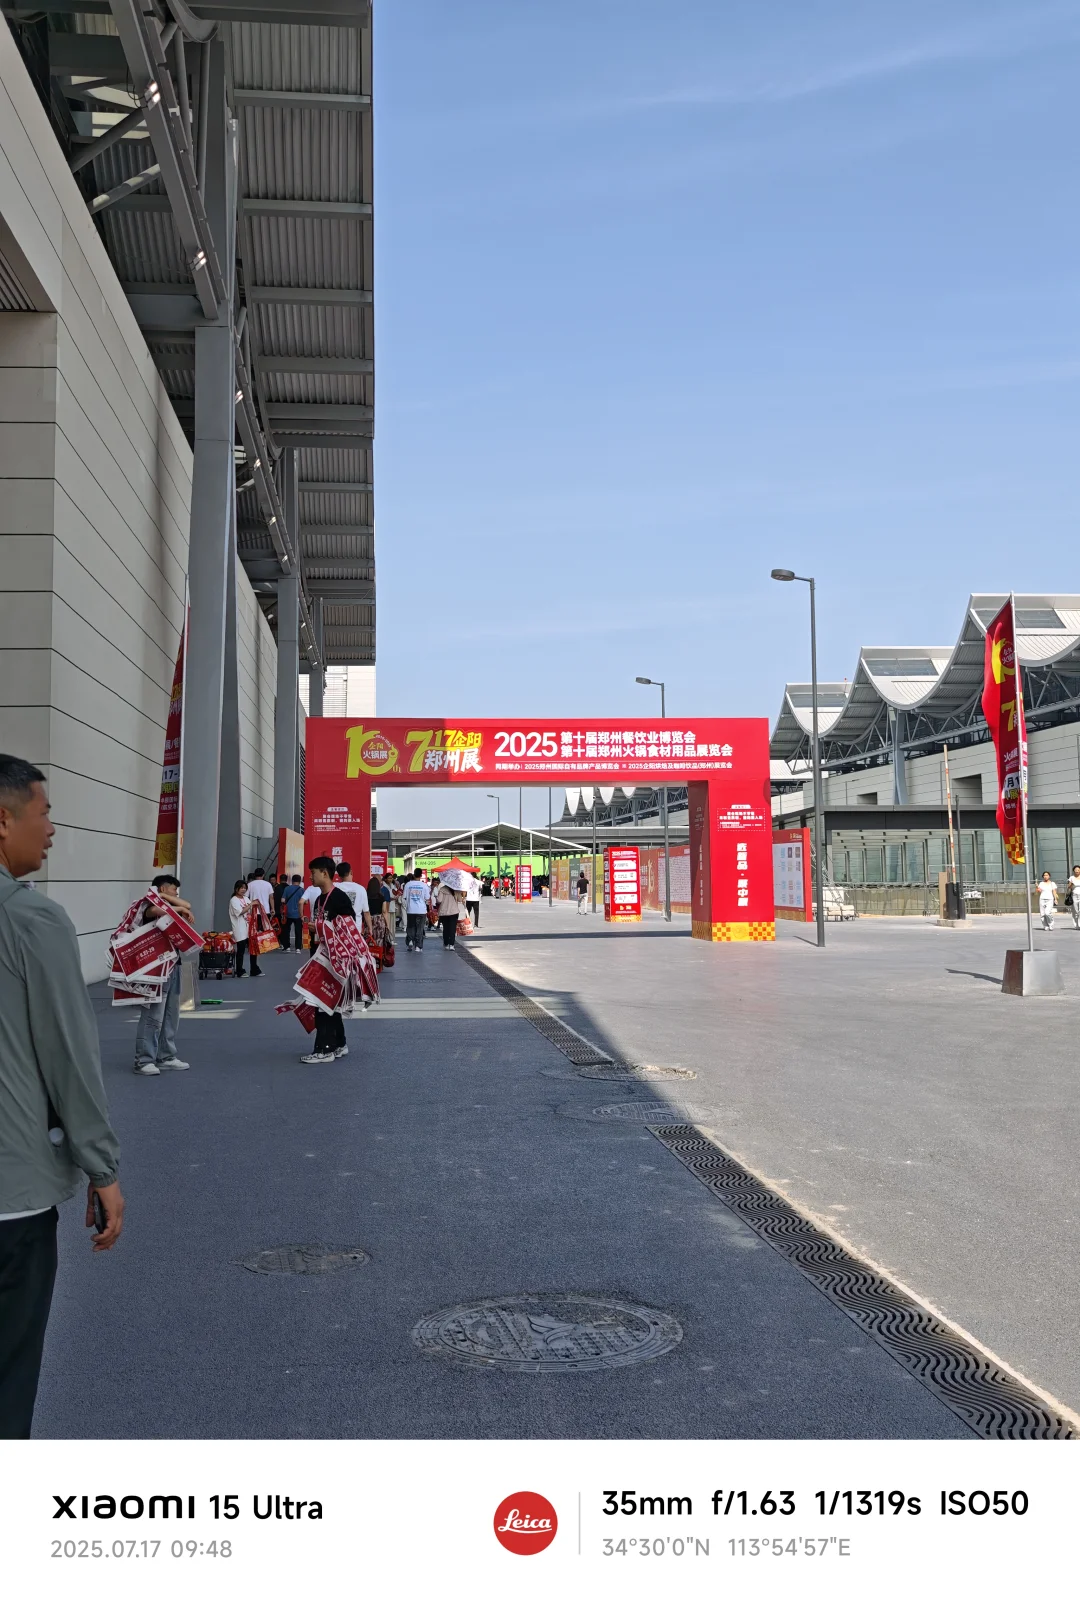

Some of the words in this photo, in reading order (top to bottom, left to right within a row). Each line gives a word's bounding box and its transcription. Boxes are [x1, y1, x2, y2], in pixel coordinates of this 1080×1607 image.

[560, 731, 696, 744] 第十届郑州餐饮业博览会
[494, 731, 558, 758] 2025
[561, 744, 733, 757] 第十届郑州火锅食材用品展览会
[363, 750, 388, 759] 火锅展
[424, 747, 483, 773] 郑州展
